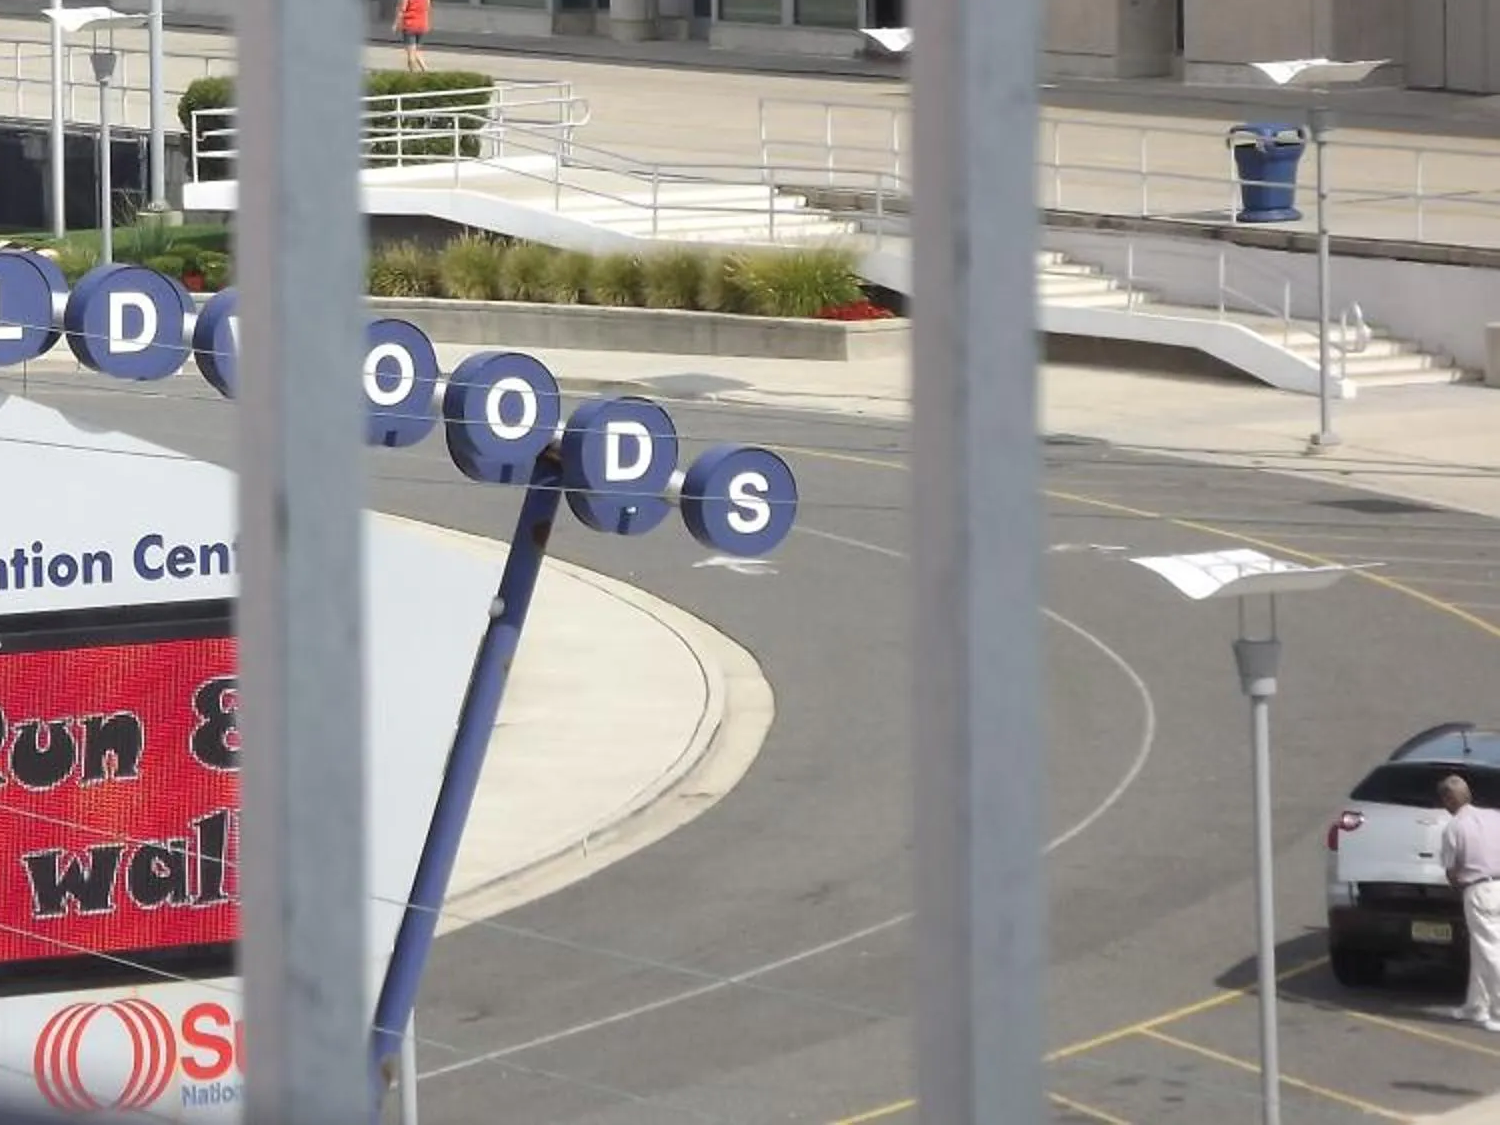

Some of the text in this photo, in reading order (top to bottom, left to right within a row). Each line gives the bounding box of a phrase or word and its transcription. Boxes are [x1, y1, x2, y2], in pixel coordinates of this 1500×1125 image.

[132, 533, 238, 581] Cen
[21, 807, 241, 920] wal
[182, 1082, 243, 1108] Natio
